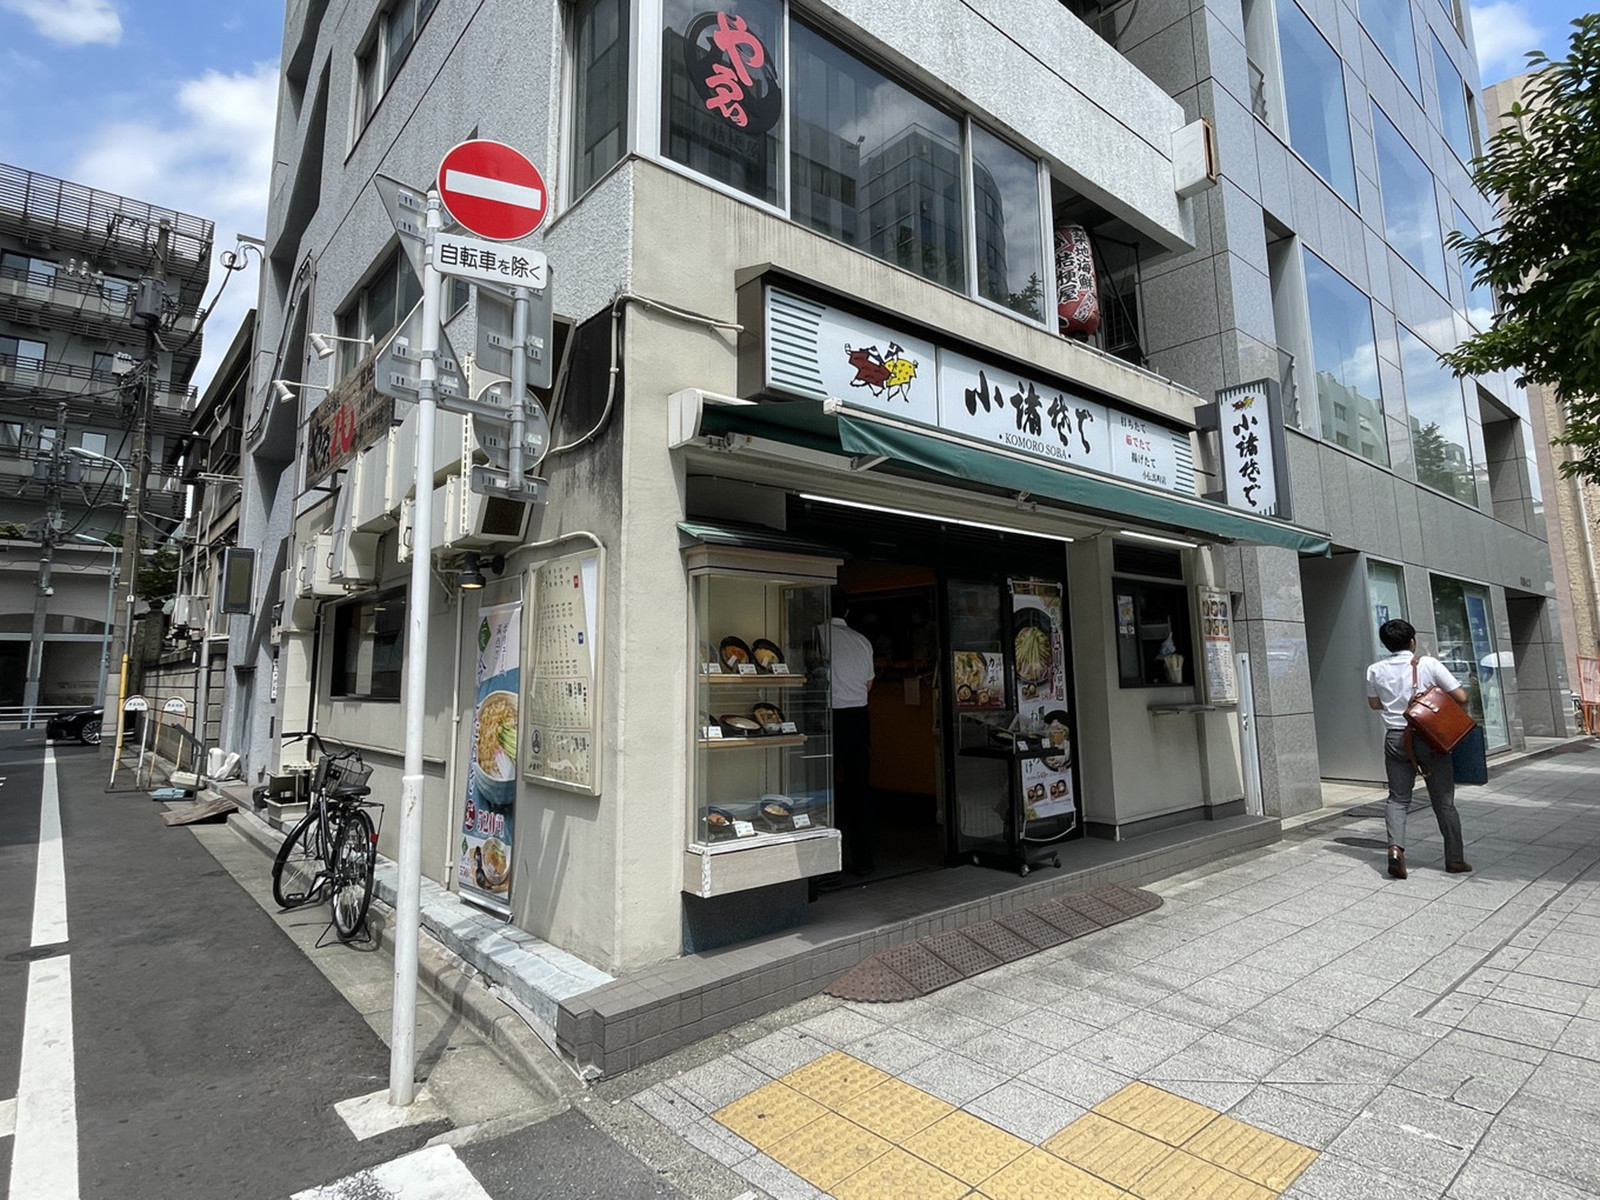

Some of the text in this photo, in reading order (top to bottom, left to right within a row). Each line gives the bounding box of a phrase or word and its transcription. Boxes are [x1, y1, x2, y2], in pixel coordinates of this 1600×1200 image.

[441, 243, 541, 280] 自転車を除く
[1121, 416, 1146, 434] 打ちたて
[1005, 432, 1067, 460] KOMORO SOBA
